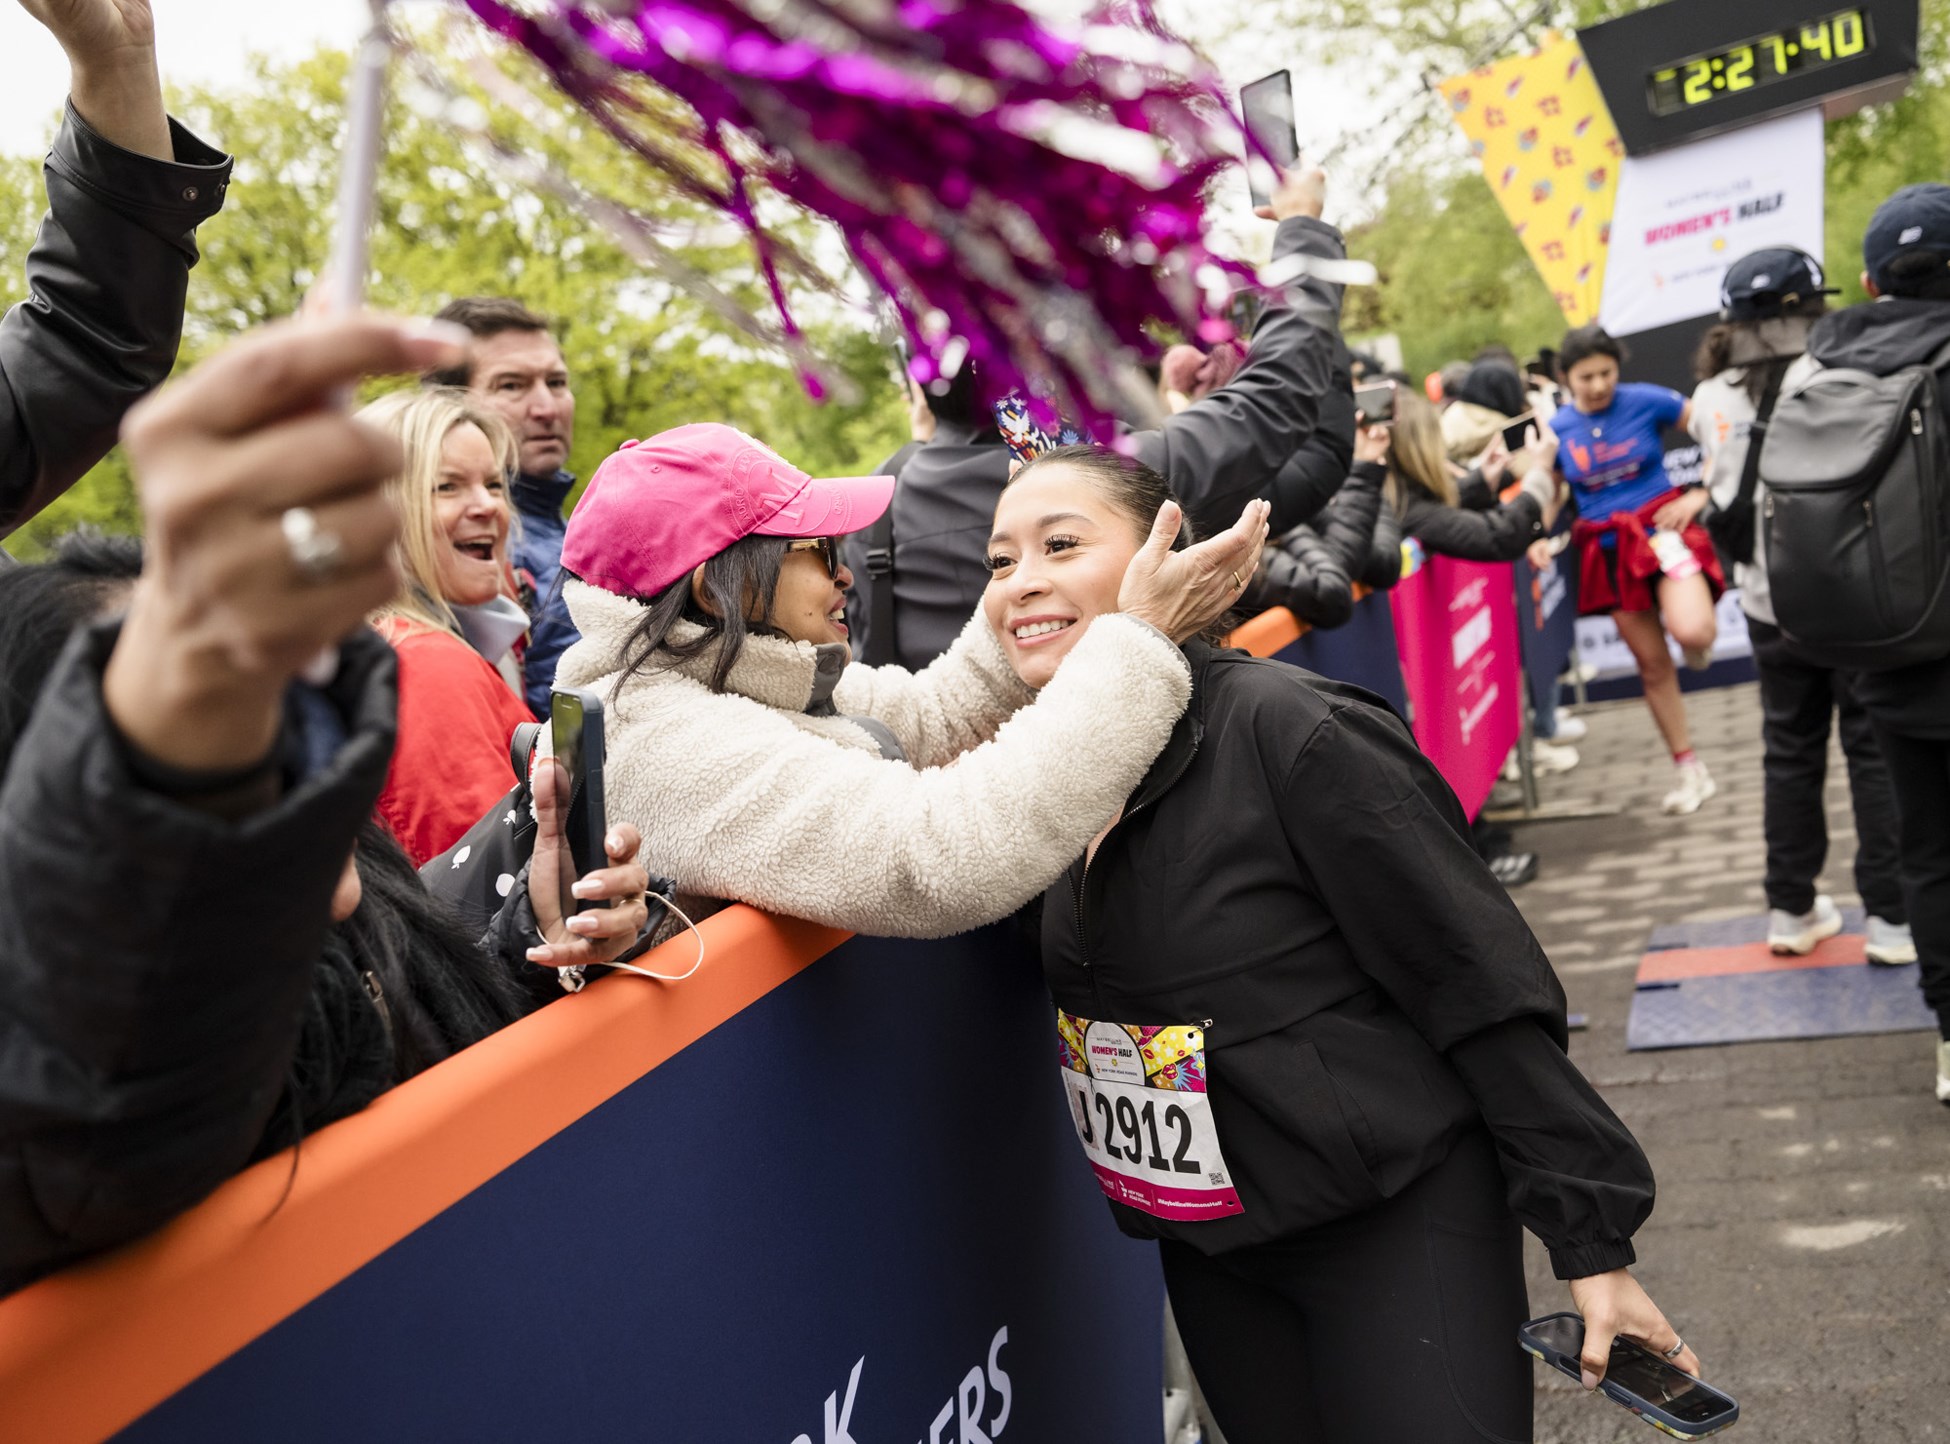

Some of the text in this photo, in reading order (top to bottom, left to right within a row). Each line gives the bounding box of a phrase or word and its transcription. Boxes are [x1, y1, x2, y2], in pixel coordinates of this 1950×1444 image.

[1738, 192, 1785, 220] HALF
[1091, 1045, 1132, 1057] WOMEN'S HALF
